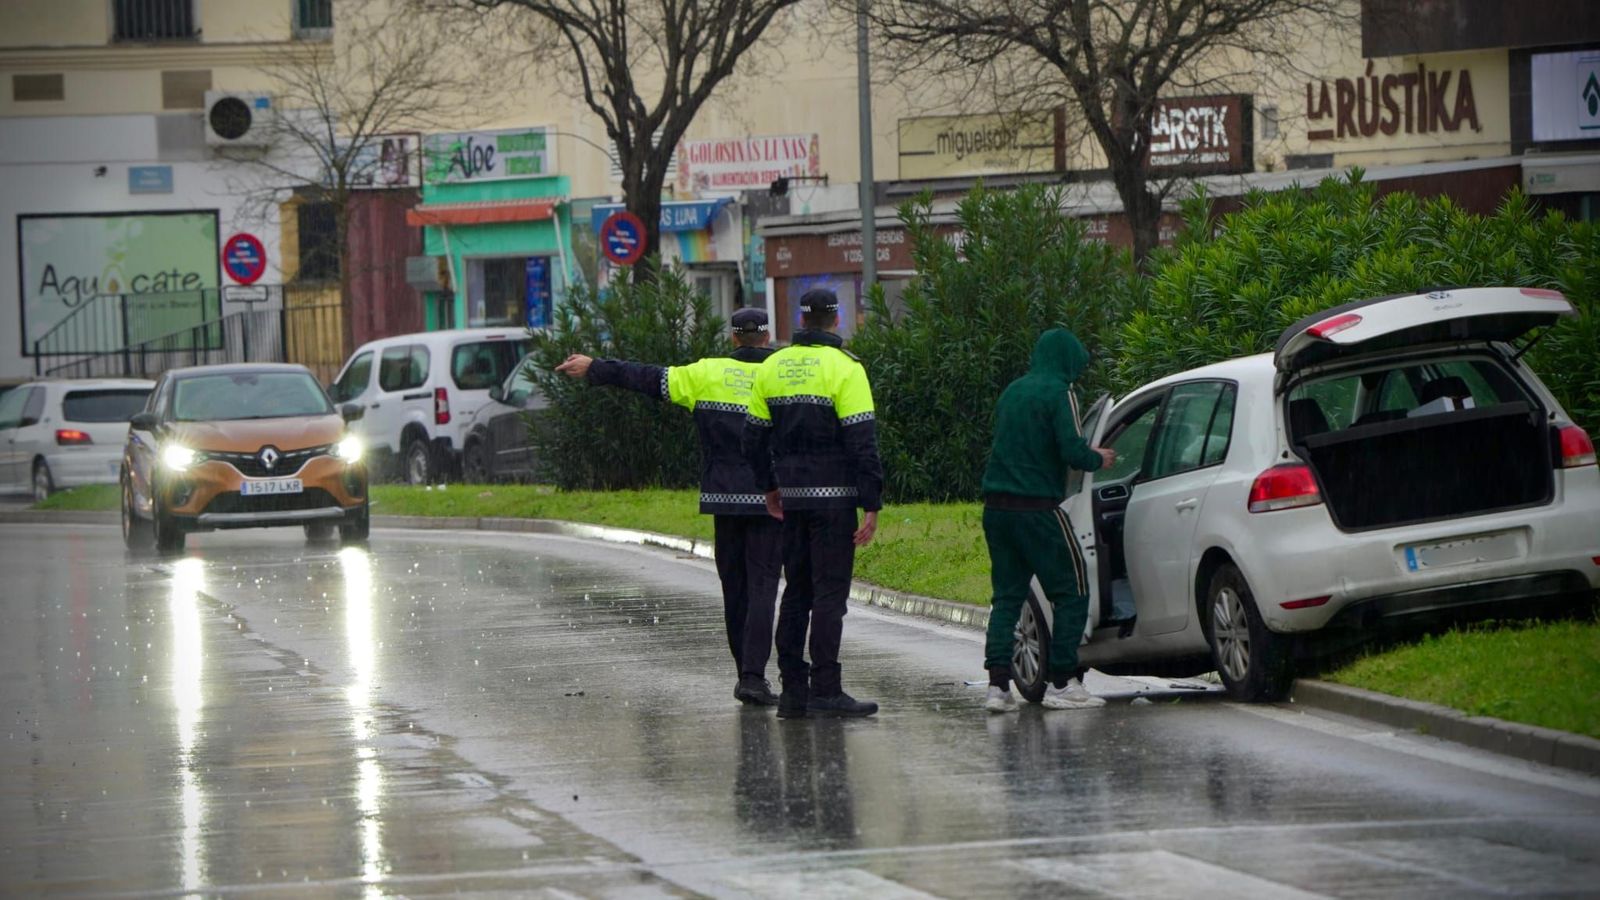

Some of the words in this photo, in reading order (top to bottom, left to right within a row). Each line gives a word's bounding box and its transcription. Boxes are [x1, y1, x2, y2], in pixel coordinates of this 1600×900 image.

[1307, 80, 1333, 120] LA
[1335, 59, 1480, 139] RÚSTIKA
[450, 136, 496, 179] Aloe
[689, 141, 760, 163] GOLOSINAS
[764, 137, 808, 161] LUNAS
[778, 369, 815, 378] LOCAL
[249, 481, 275, 493] 1517
[280, 480, 300, 492] LKR
